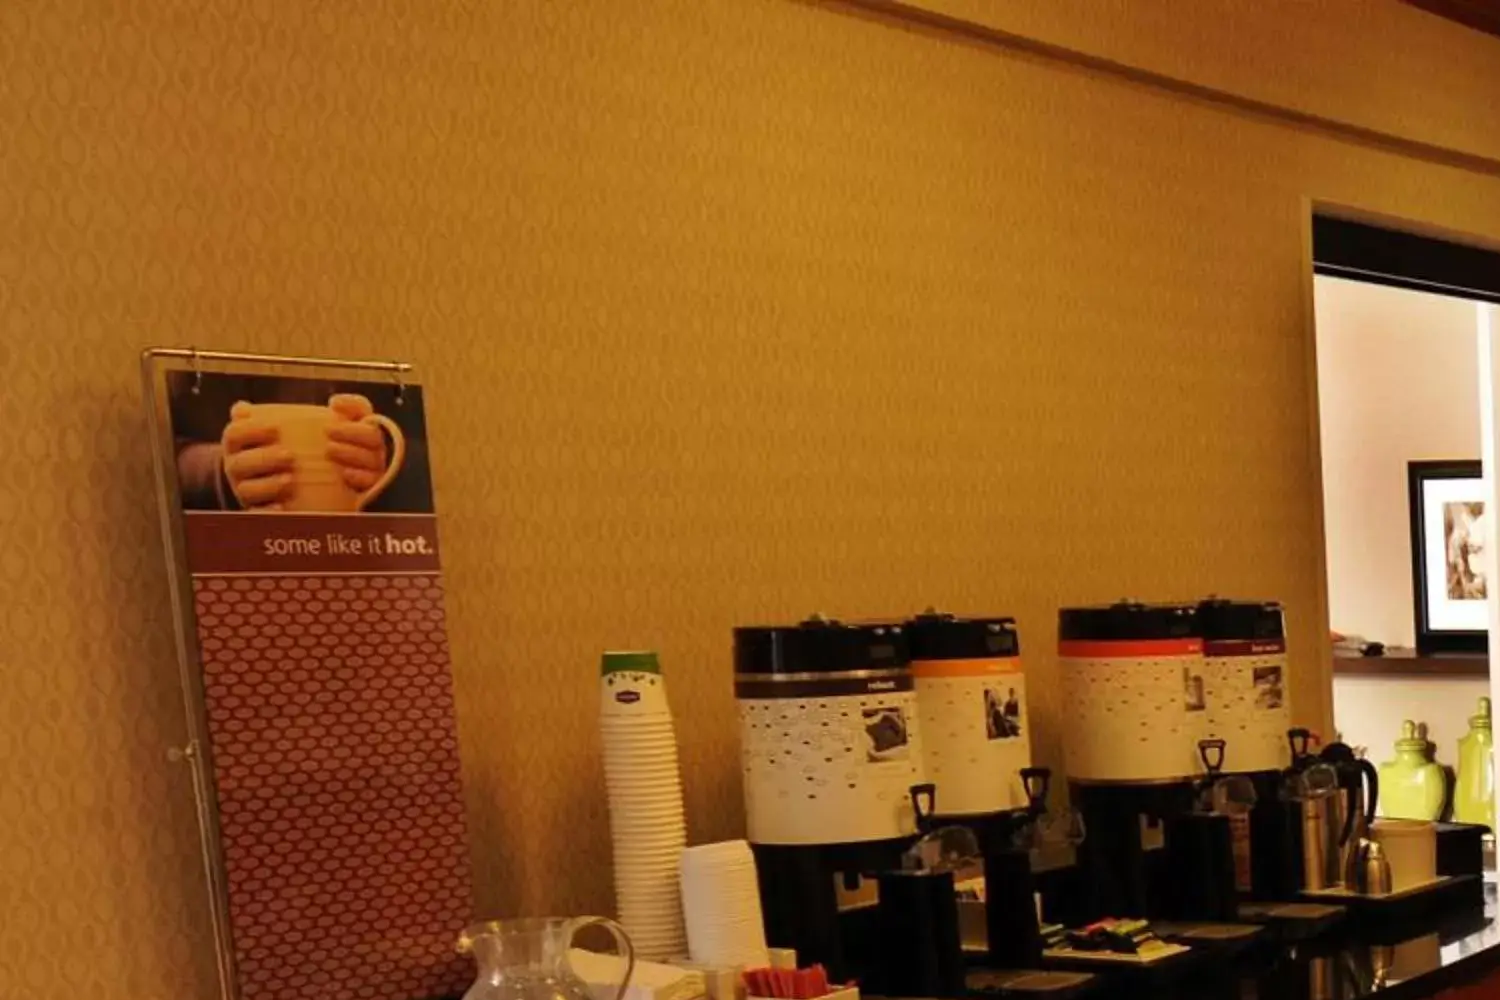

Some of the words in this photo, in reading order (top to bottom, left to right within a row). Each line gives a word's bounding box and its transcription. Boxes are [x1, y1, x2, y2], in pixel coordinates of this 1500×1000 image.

[263, 537, 321, 556] some
[326, 533, 362, 556] like
[368, 534, 382, 555] it
[385, 532, 433, 555] hot.
